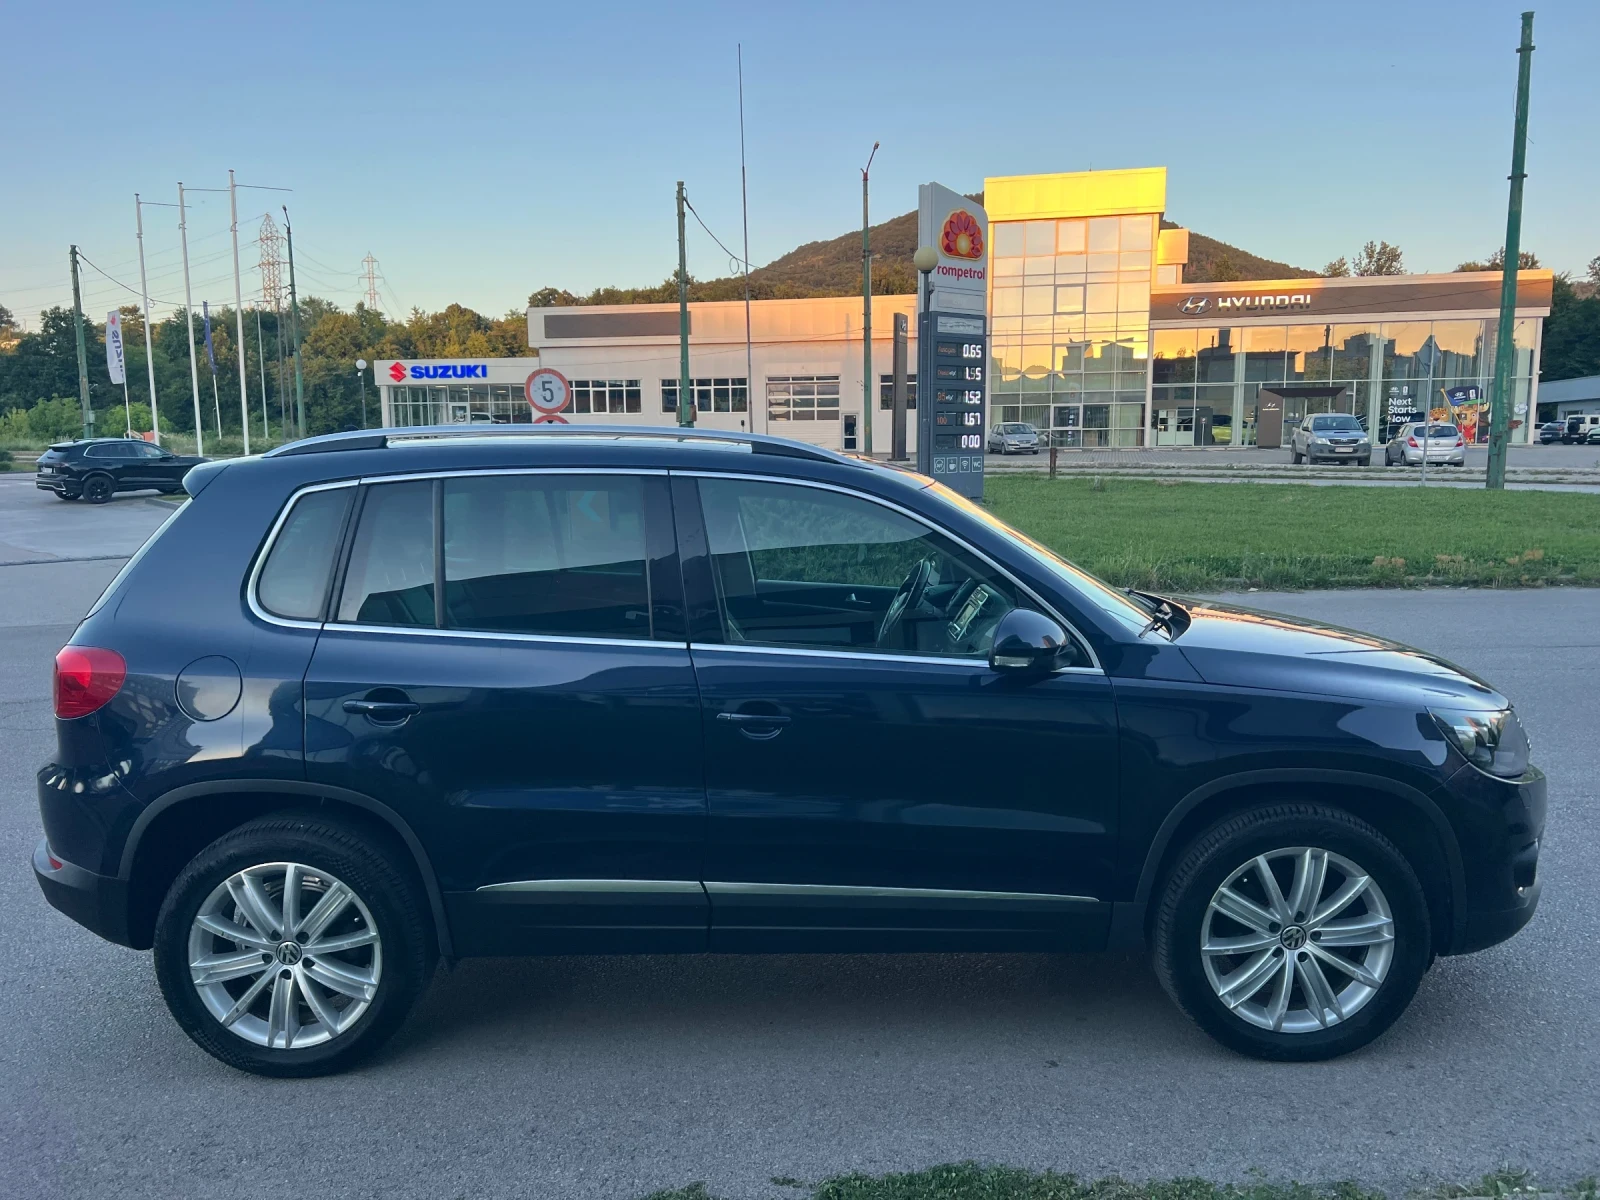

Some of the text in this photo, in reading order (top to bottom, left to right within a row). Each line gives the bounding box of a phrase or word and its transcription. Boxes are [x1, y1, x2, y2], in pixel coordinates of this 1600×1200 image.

[937, 265, 985, 281] rompetrol
[1218, 294, 1311, 311] HYUNDAI
[963, 344, 982, 358] 0.65
[410, 364, 487, 379] SUZUKI
[965, 366, 982, 380] 1.55
[541, 380, 554, 403] 5
[965, 390, 981, 404] 1.52
[1388, 398, 1412, 406] Next
[1388, 406, 1417, 414] Starts
[964, 412, 981, 426] 1.67
